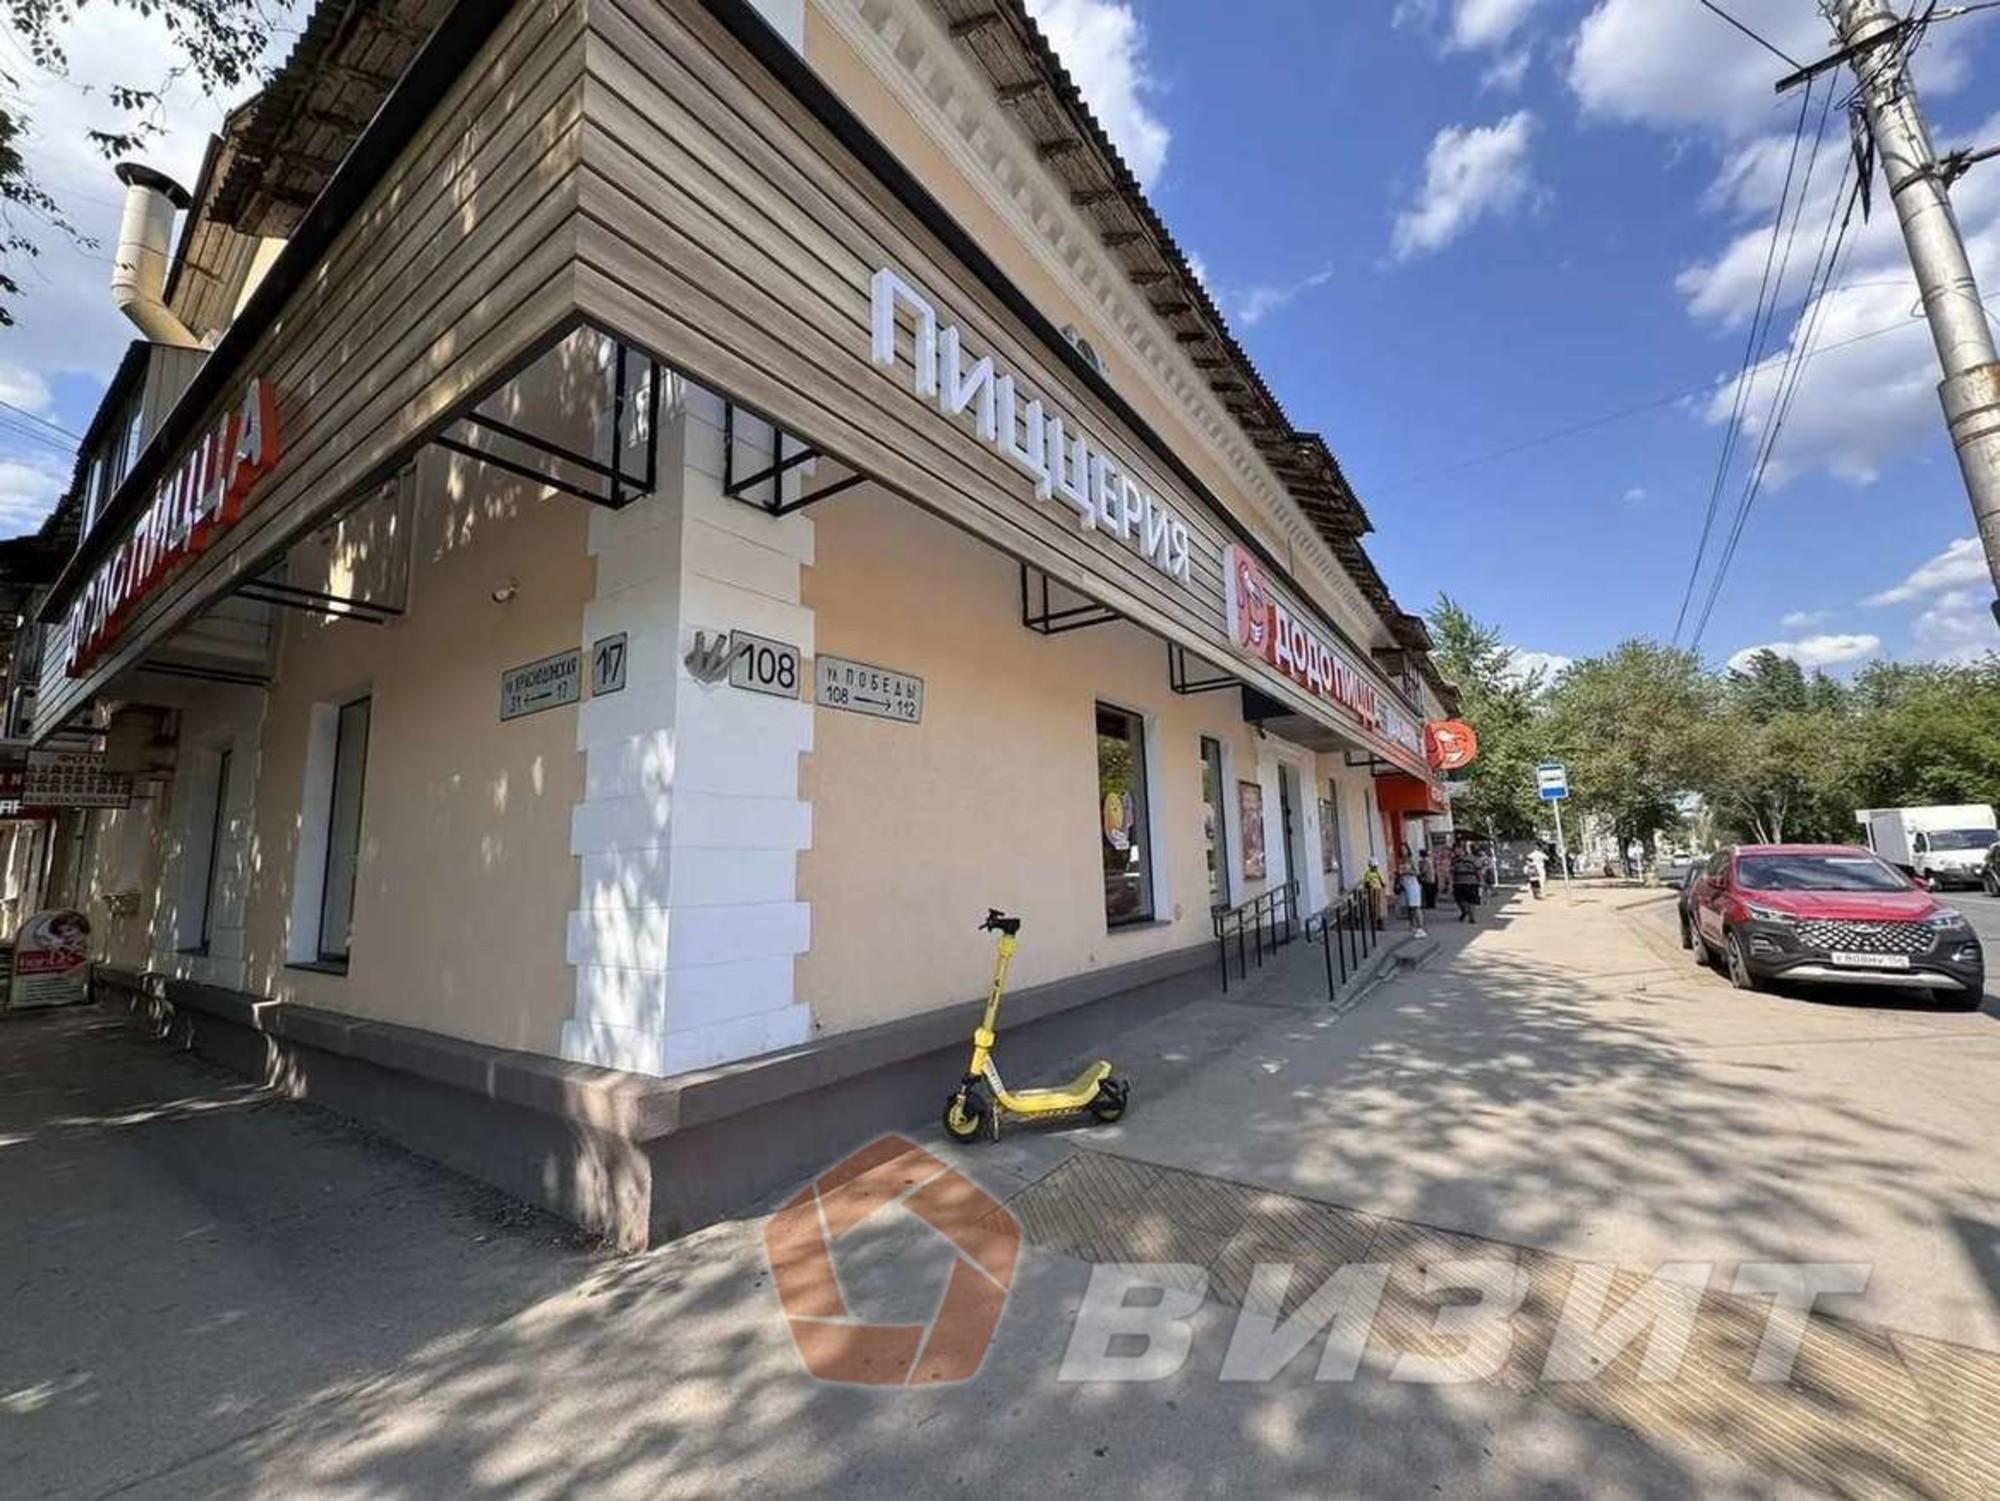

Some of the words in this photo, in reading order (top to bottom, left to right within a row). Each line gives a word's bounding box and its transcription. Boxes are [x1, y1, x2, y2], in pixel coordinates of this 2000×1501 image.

[871, 267, 1190, 583] ПИЦЦЕРИЯ
[596, 643, 623, 685] 17
[739, 643, 795, 689] 108
[846, 667, 916, 700] ПОБЕДЫ
[826, 685, 849, 705] 108
[897, 699, 916, 719] 112
